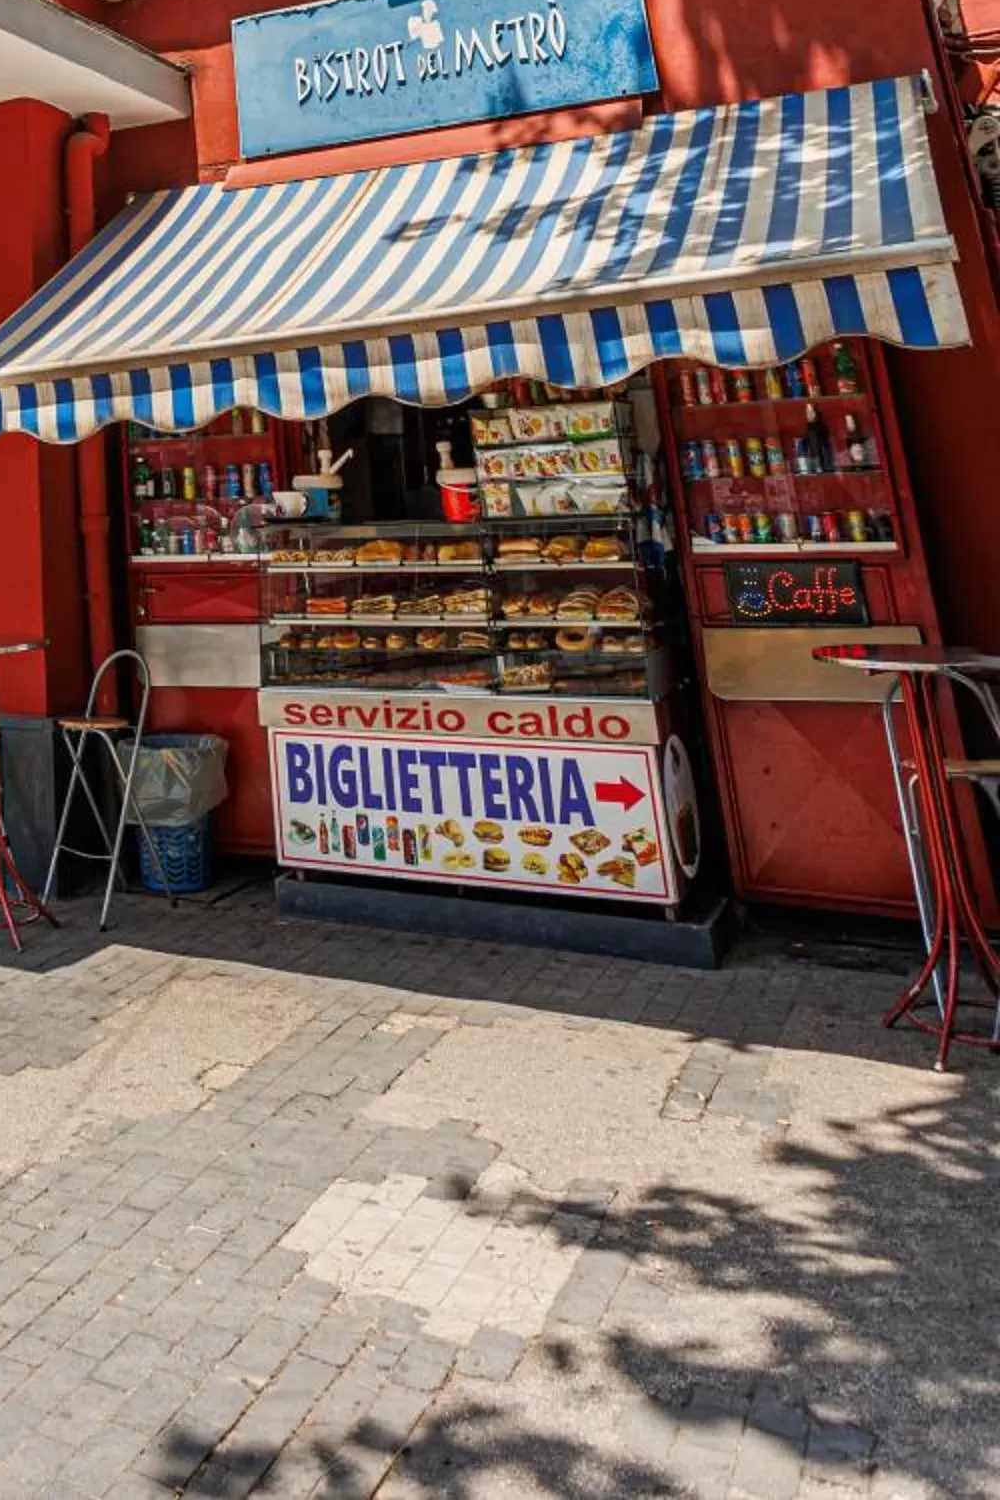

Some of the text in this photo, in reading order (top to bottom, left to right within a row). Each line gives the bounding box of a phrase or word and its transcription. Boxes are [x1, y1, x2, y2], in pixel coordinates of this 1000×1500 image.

[283, 699, 632, 740] servizio caldo
[285, 741, 597, 827] BIGLIETTERIA
